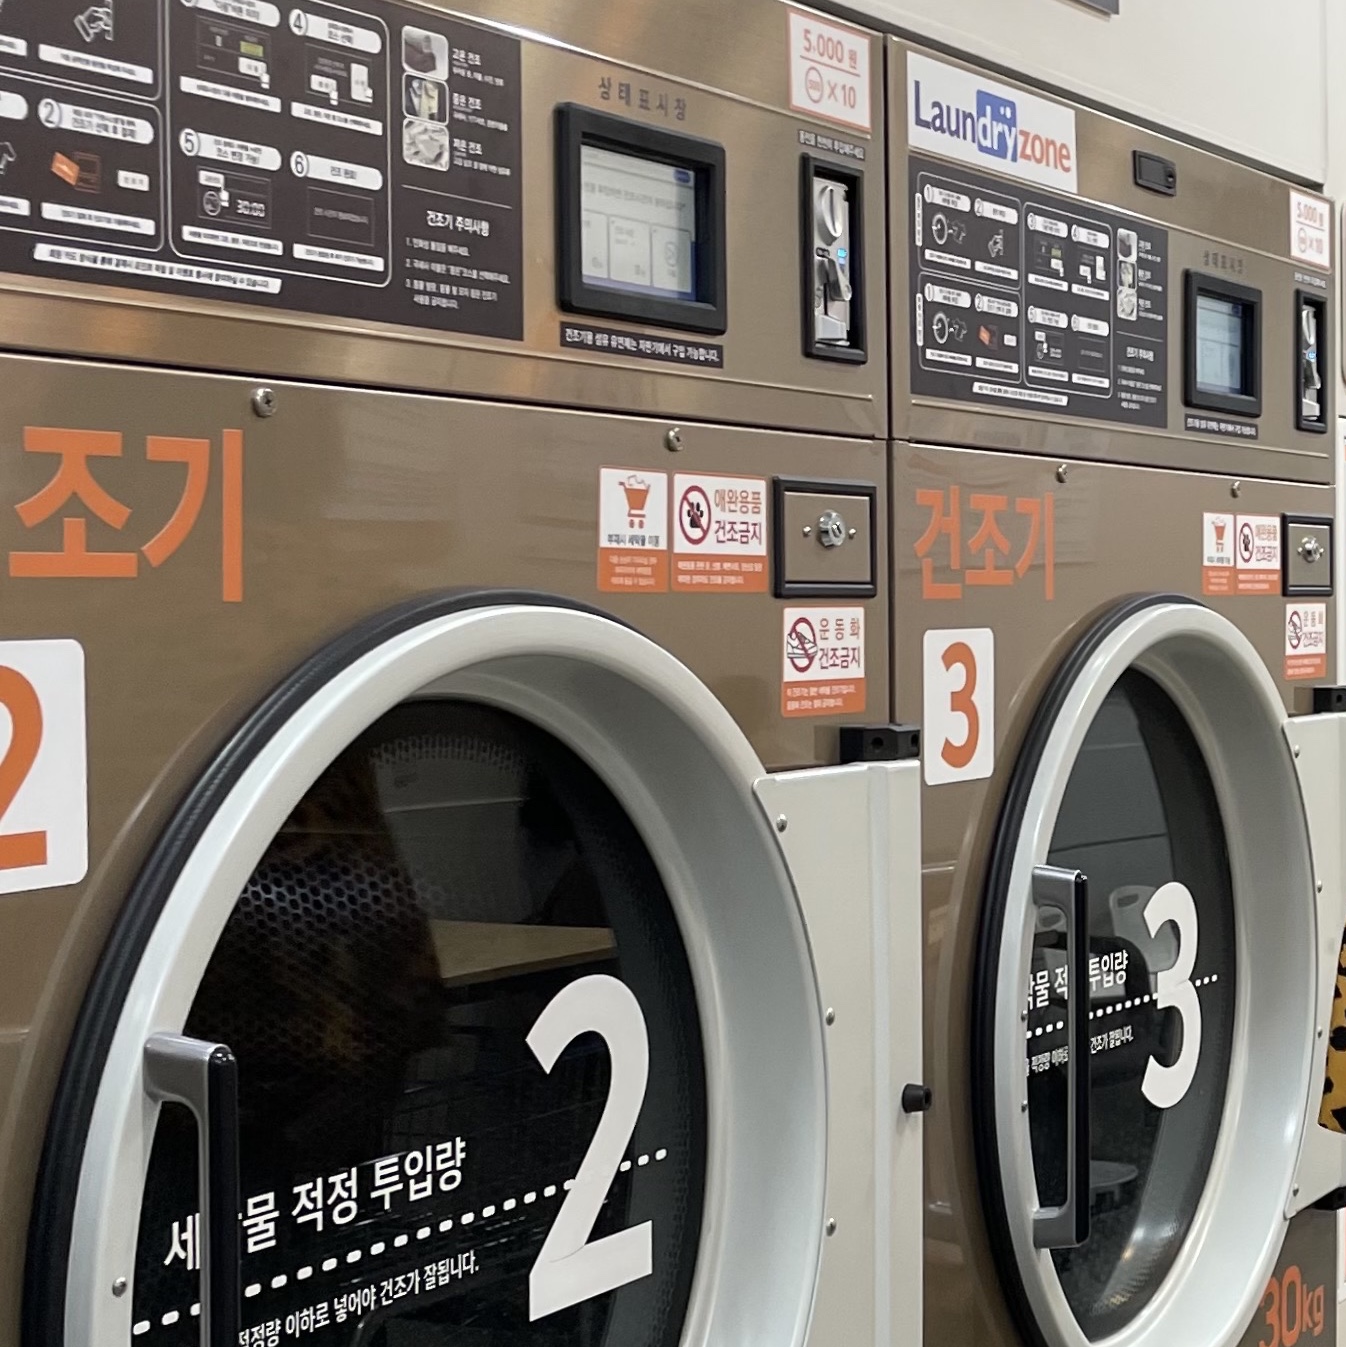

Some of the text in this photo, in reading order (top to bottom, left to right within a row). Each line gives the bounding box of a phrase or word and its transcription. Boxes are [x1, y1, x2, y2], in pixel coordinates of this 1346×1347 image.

[598, 77, 687, 121] 상태표시창
[842, 84, 857, 109] 10
[426, 210, 453, 230] 건조기
[714, 489, 762, 515] 애완용품
[714, 520, 762, 546] 건조금지
[913, 486, 1054, 600] 건조기
[819, 646, 860, 669] 건조금지
[940, 642, 979, 768] 3
[1141, 881, 1202, 1109] 3
[525, 973, 653, 1322] 2
[163, 1136, 467, 1270] 세물 적정 투입량
[285, 1301, 330, 1338] 이하로
[334, 1284, 377, 1322] 넣어야
[379, 1268, 421, 1306] 건조가
[423, 1249, 480, 1291] 잘됩니다.
